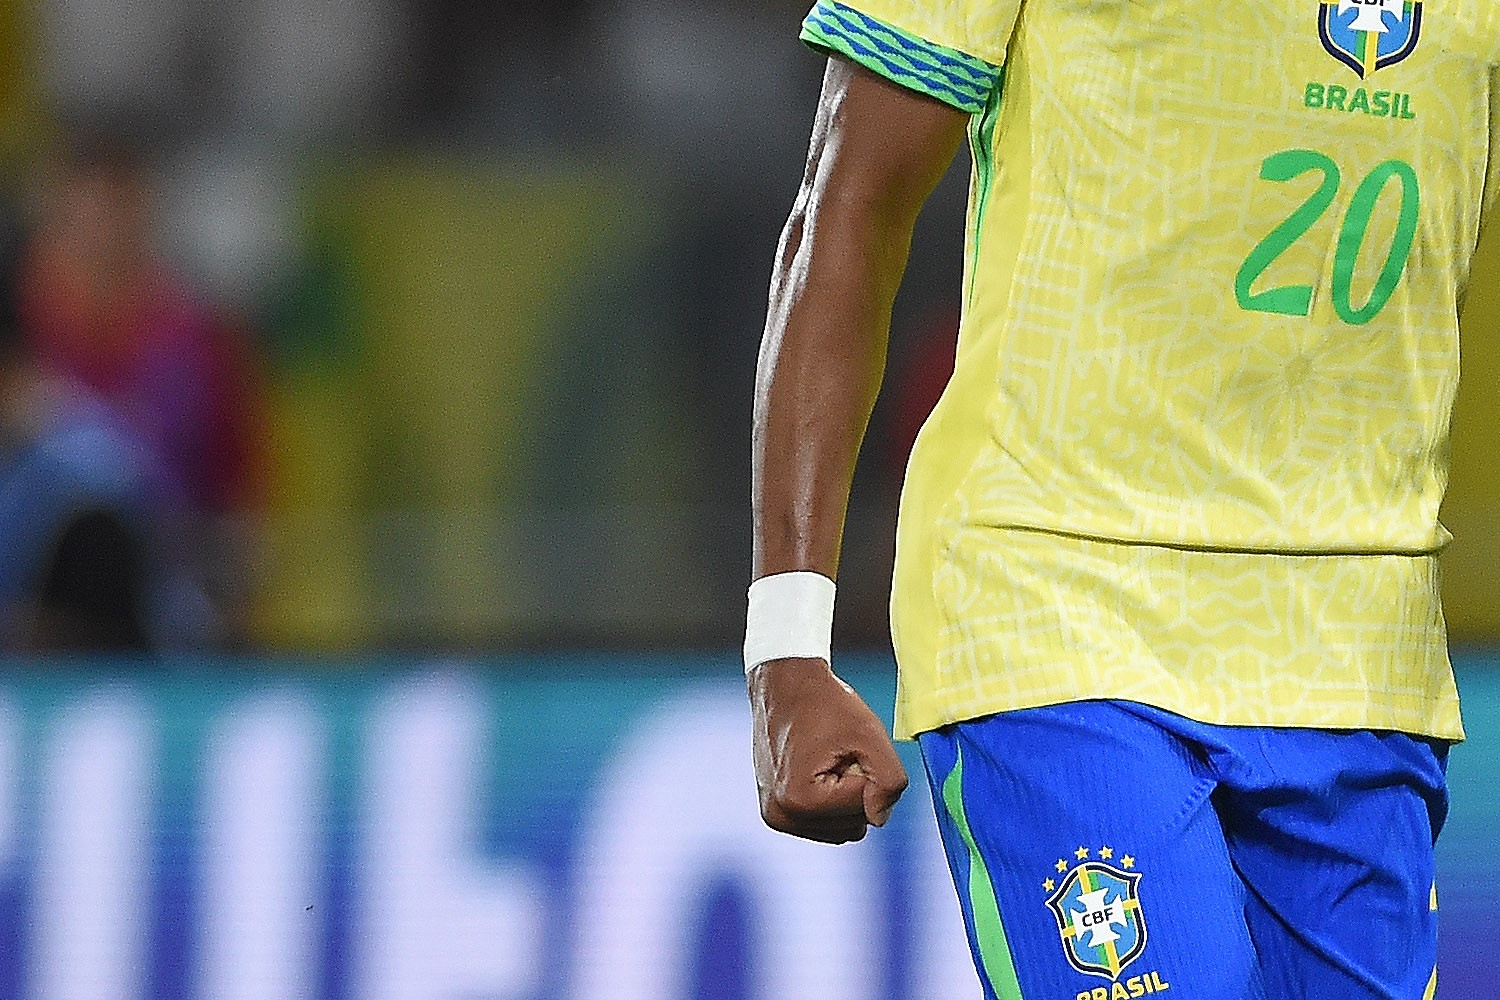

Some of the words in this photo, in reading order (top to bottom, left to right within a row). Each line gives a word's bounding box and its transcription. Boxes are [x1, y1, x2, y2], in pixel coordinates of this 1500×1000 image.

[1304, 83, 1416, 119] BRASIL
[1234, 149, 1421, 326] 20
[1082, 907, 1114, 927] CBF
